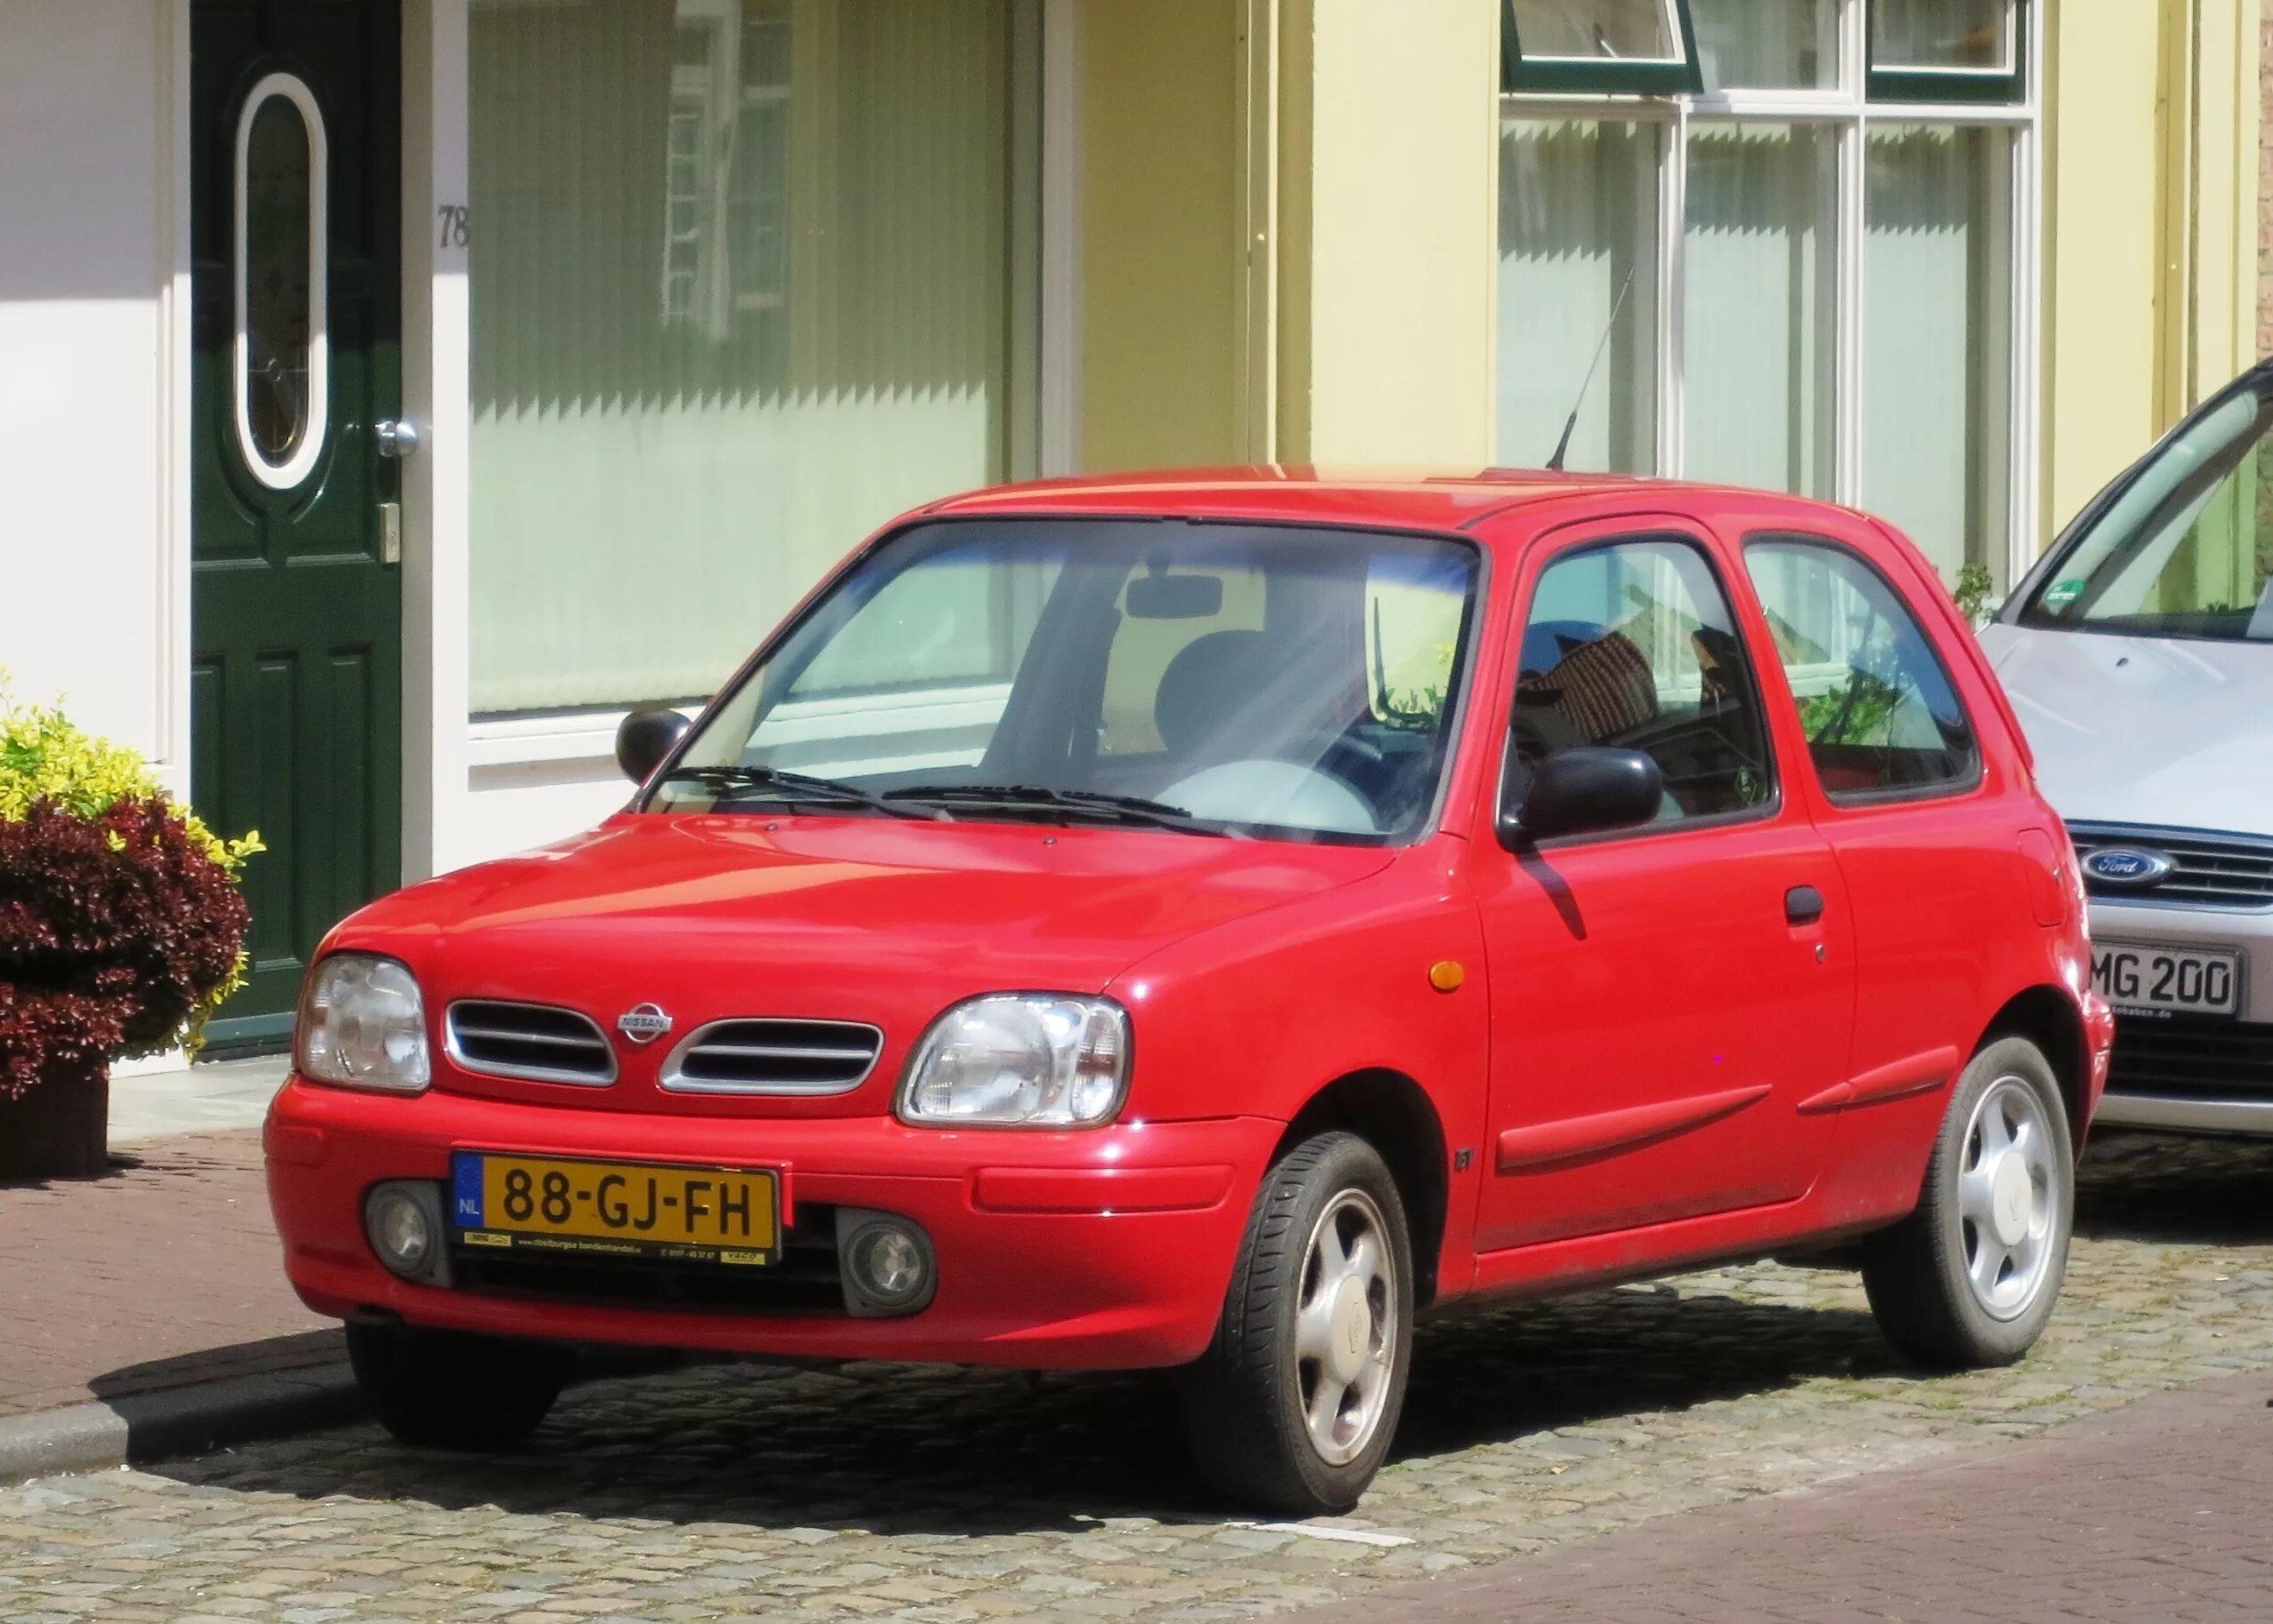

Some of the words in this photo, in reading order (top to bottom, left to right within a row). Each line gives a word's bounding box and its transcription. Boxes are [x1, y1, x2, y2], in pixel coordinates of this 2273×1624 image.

[438, 204, 469, 248] 78
[2098, 857, 2139, 873] Ford
[2149, 956, 2230, 1005] 200
[621, 1017, 664, 1028] NISSAN
[459, 1198, 480, 1215] NL
[503, 1168, 750, 1236] 88-GJ-FH
